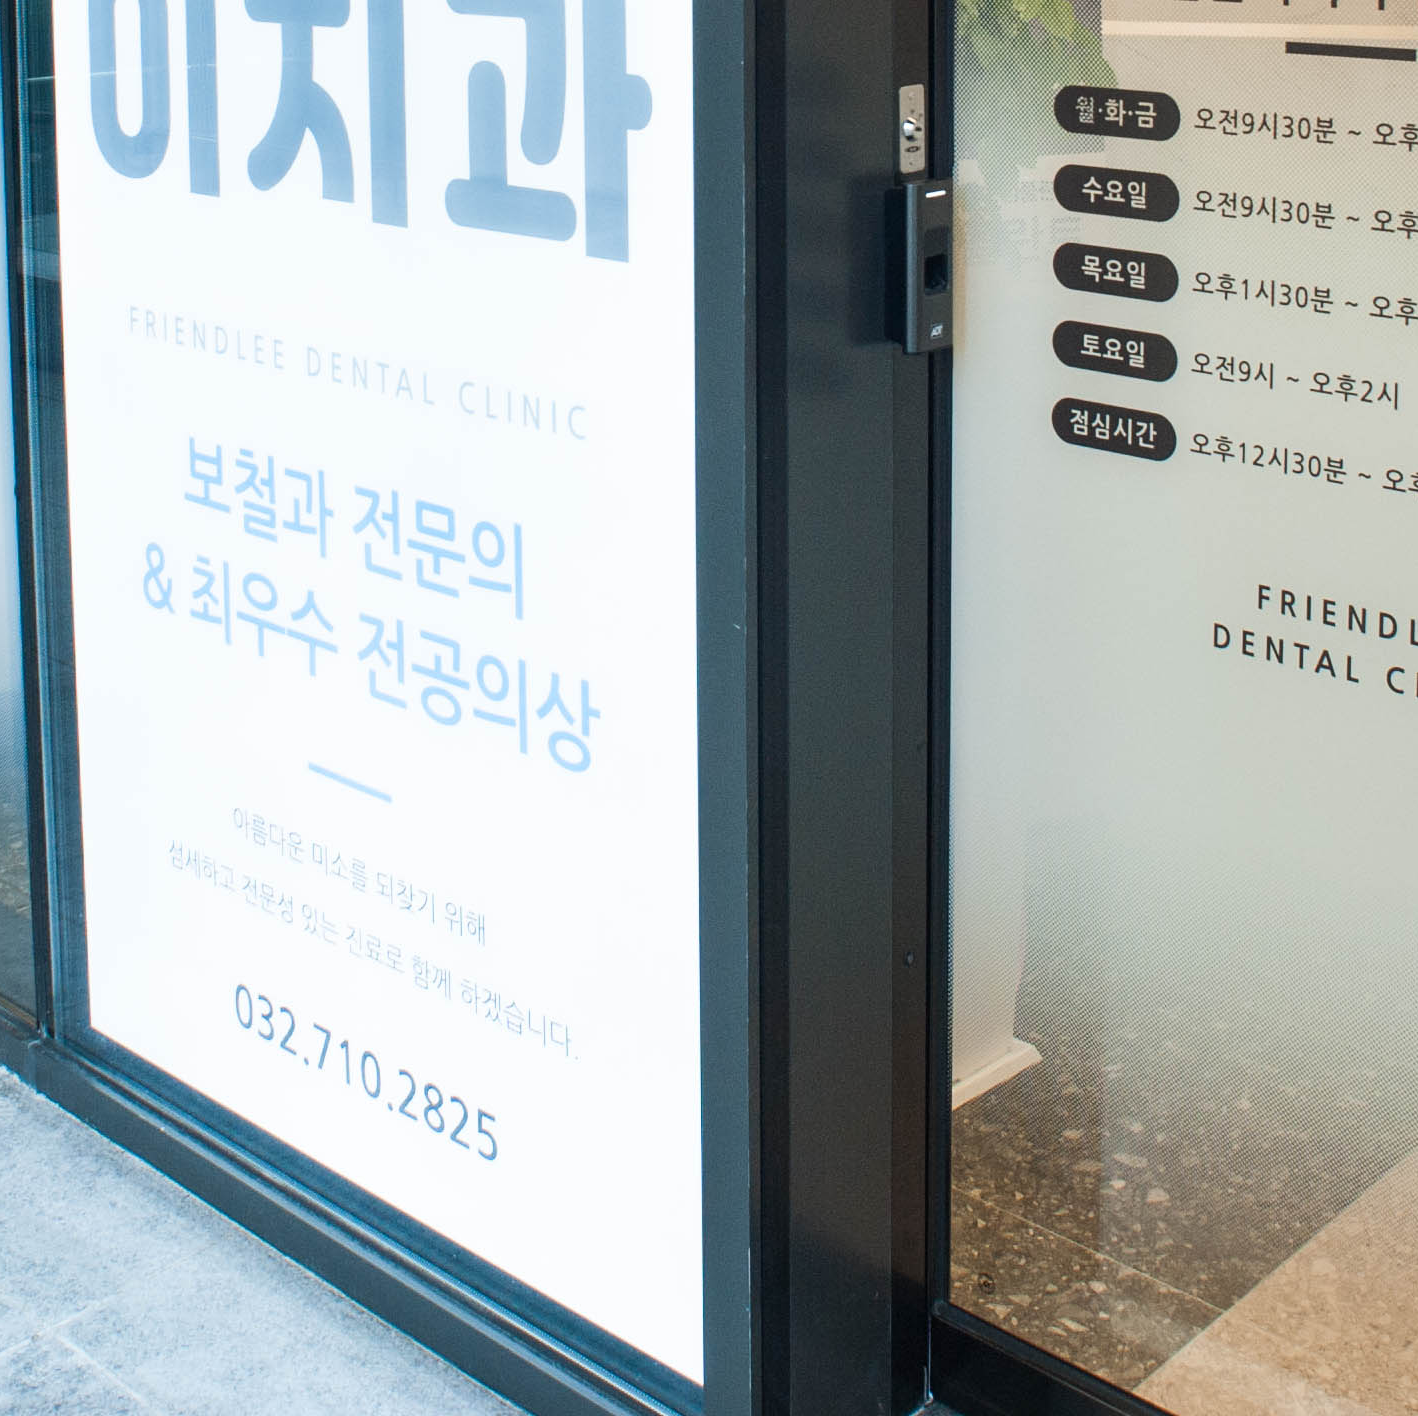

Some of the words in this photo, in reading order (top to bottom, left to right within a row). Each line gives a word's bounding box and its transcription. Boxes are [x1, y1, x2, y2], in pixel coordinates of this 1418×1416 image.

[1194, 107, 1337, 146] 오전9시30분
[1081, 177, 1148, 209] 수요일
[1193, 189, 1336, 230] 오전9시30분
[1081, 254, 1147, 290] 목요일
[1192, 271, 1334, 315] 오후1시30분
[128, 304, 285, 371] FRIENDLEE
[306, 345, 435, 406] DENTAL
[458, 381, 588, 441] CLINIC
[1080, 333, 1146, 369] 토요일
[1191, 352, 1276, 390] 오전9시
[1309, 371, 1400, 411] 오후2시
[1069, 409, 1158, 449] 점심시간
[1190, 433, 1348, 485] 오후12시30분
[183, 436, 334, 559] 보철과
[352, 485, 524, 621] 전문의
[143, 542, 176, 615] &
[190, 553, 339, 678] 최우수
[357, 612, 601, 774] 전공의상
[1213, 622, 1360, 684] DENTAL
[233, 807, 305, 864] 아름다운
[312, 842, 369, 893] 미소를
[377, 871, 435, 925] 되찾기
[444, 901, 486, 947] 위해
[169, 839, 237, 893] 섬세하고
[242, 874, 294, 924] 전문성
[301, 903, 339, 946] 있는
[346, 923, 405, 974] 진료로
[412, 954, 452, 1001] 함께
[460, 978, 579, 1060] 하겠습니다.
[234, 982, 499, 1162] 032.710.2825
